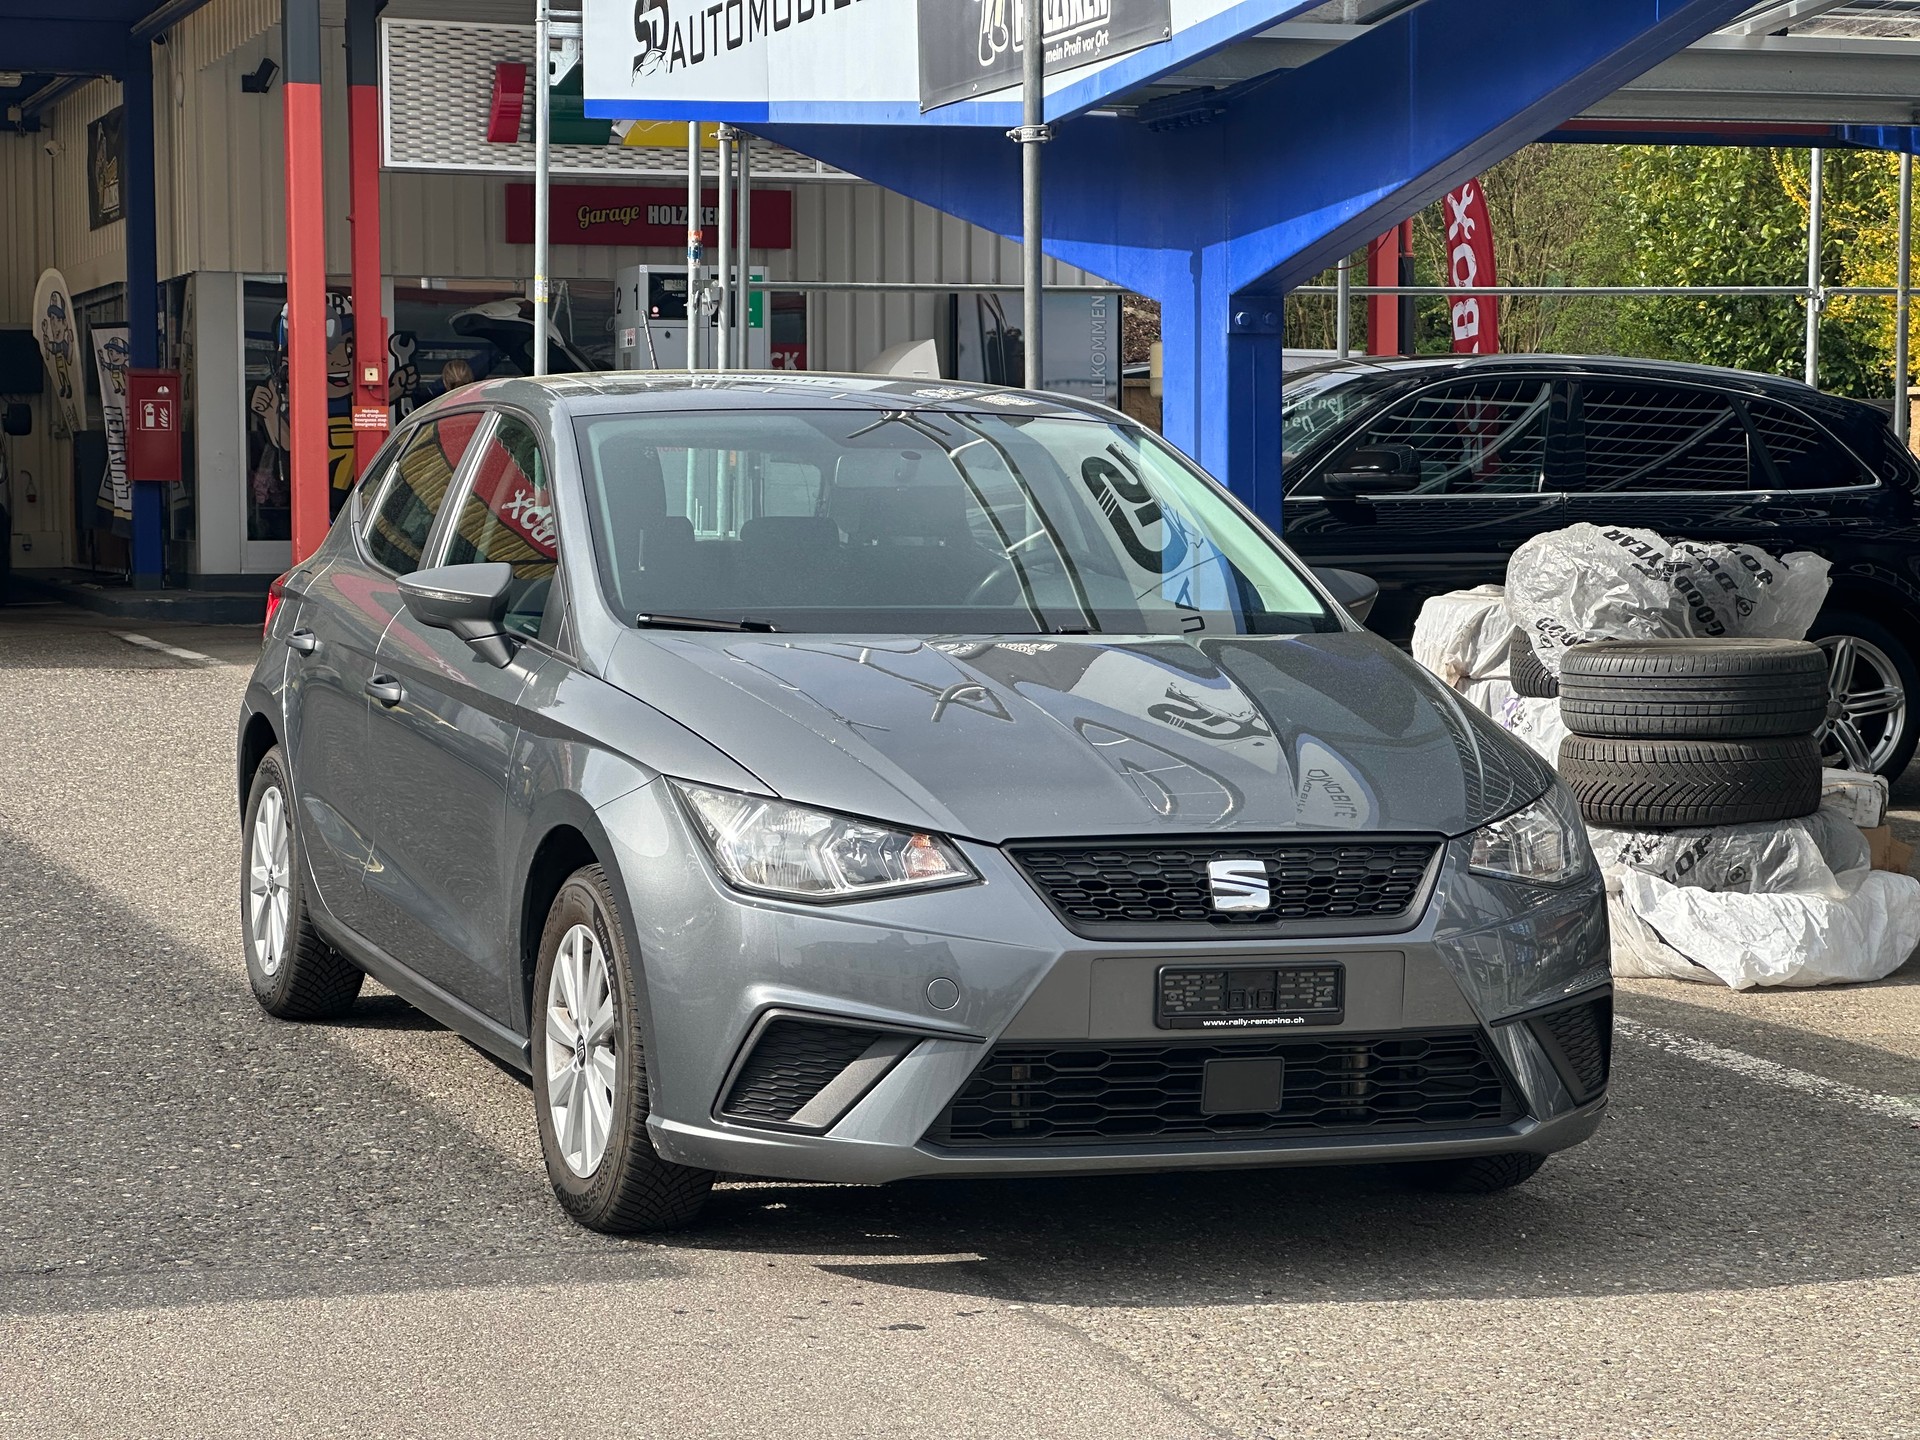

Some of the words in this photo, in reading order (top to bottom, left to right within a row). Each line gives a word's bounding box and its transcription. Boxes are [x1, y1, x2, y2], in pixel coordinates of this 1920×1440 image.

[669, 0, 862, 73] AUTOMO
[1045, 44, 1062, 64] mein
[1063, 36, 1082, 58] Profi
[1082, 37, 1095, 52] vor
[1095, 29, 1109, 49] Ort
[577, 205, 640, 229] Garage
[616, 286, 622, 315] 2
[633, 283, 639, 311] 1
[1091, 295, 1107, 403] ILLKOMMEN
[1602, 534, 1665, 567] YEAR
[1203, 1016, 1305, 1027] www.rally-remorino.ch
